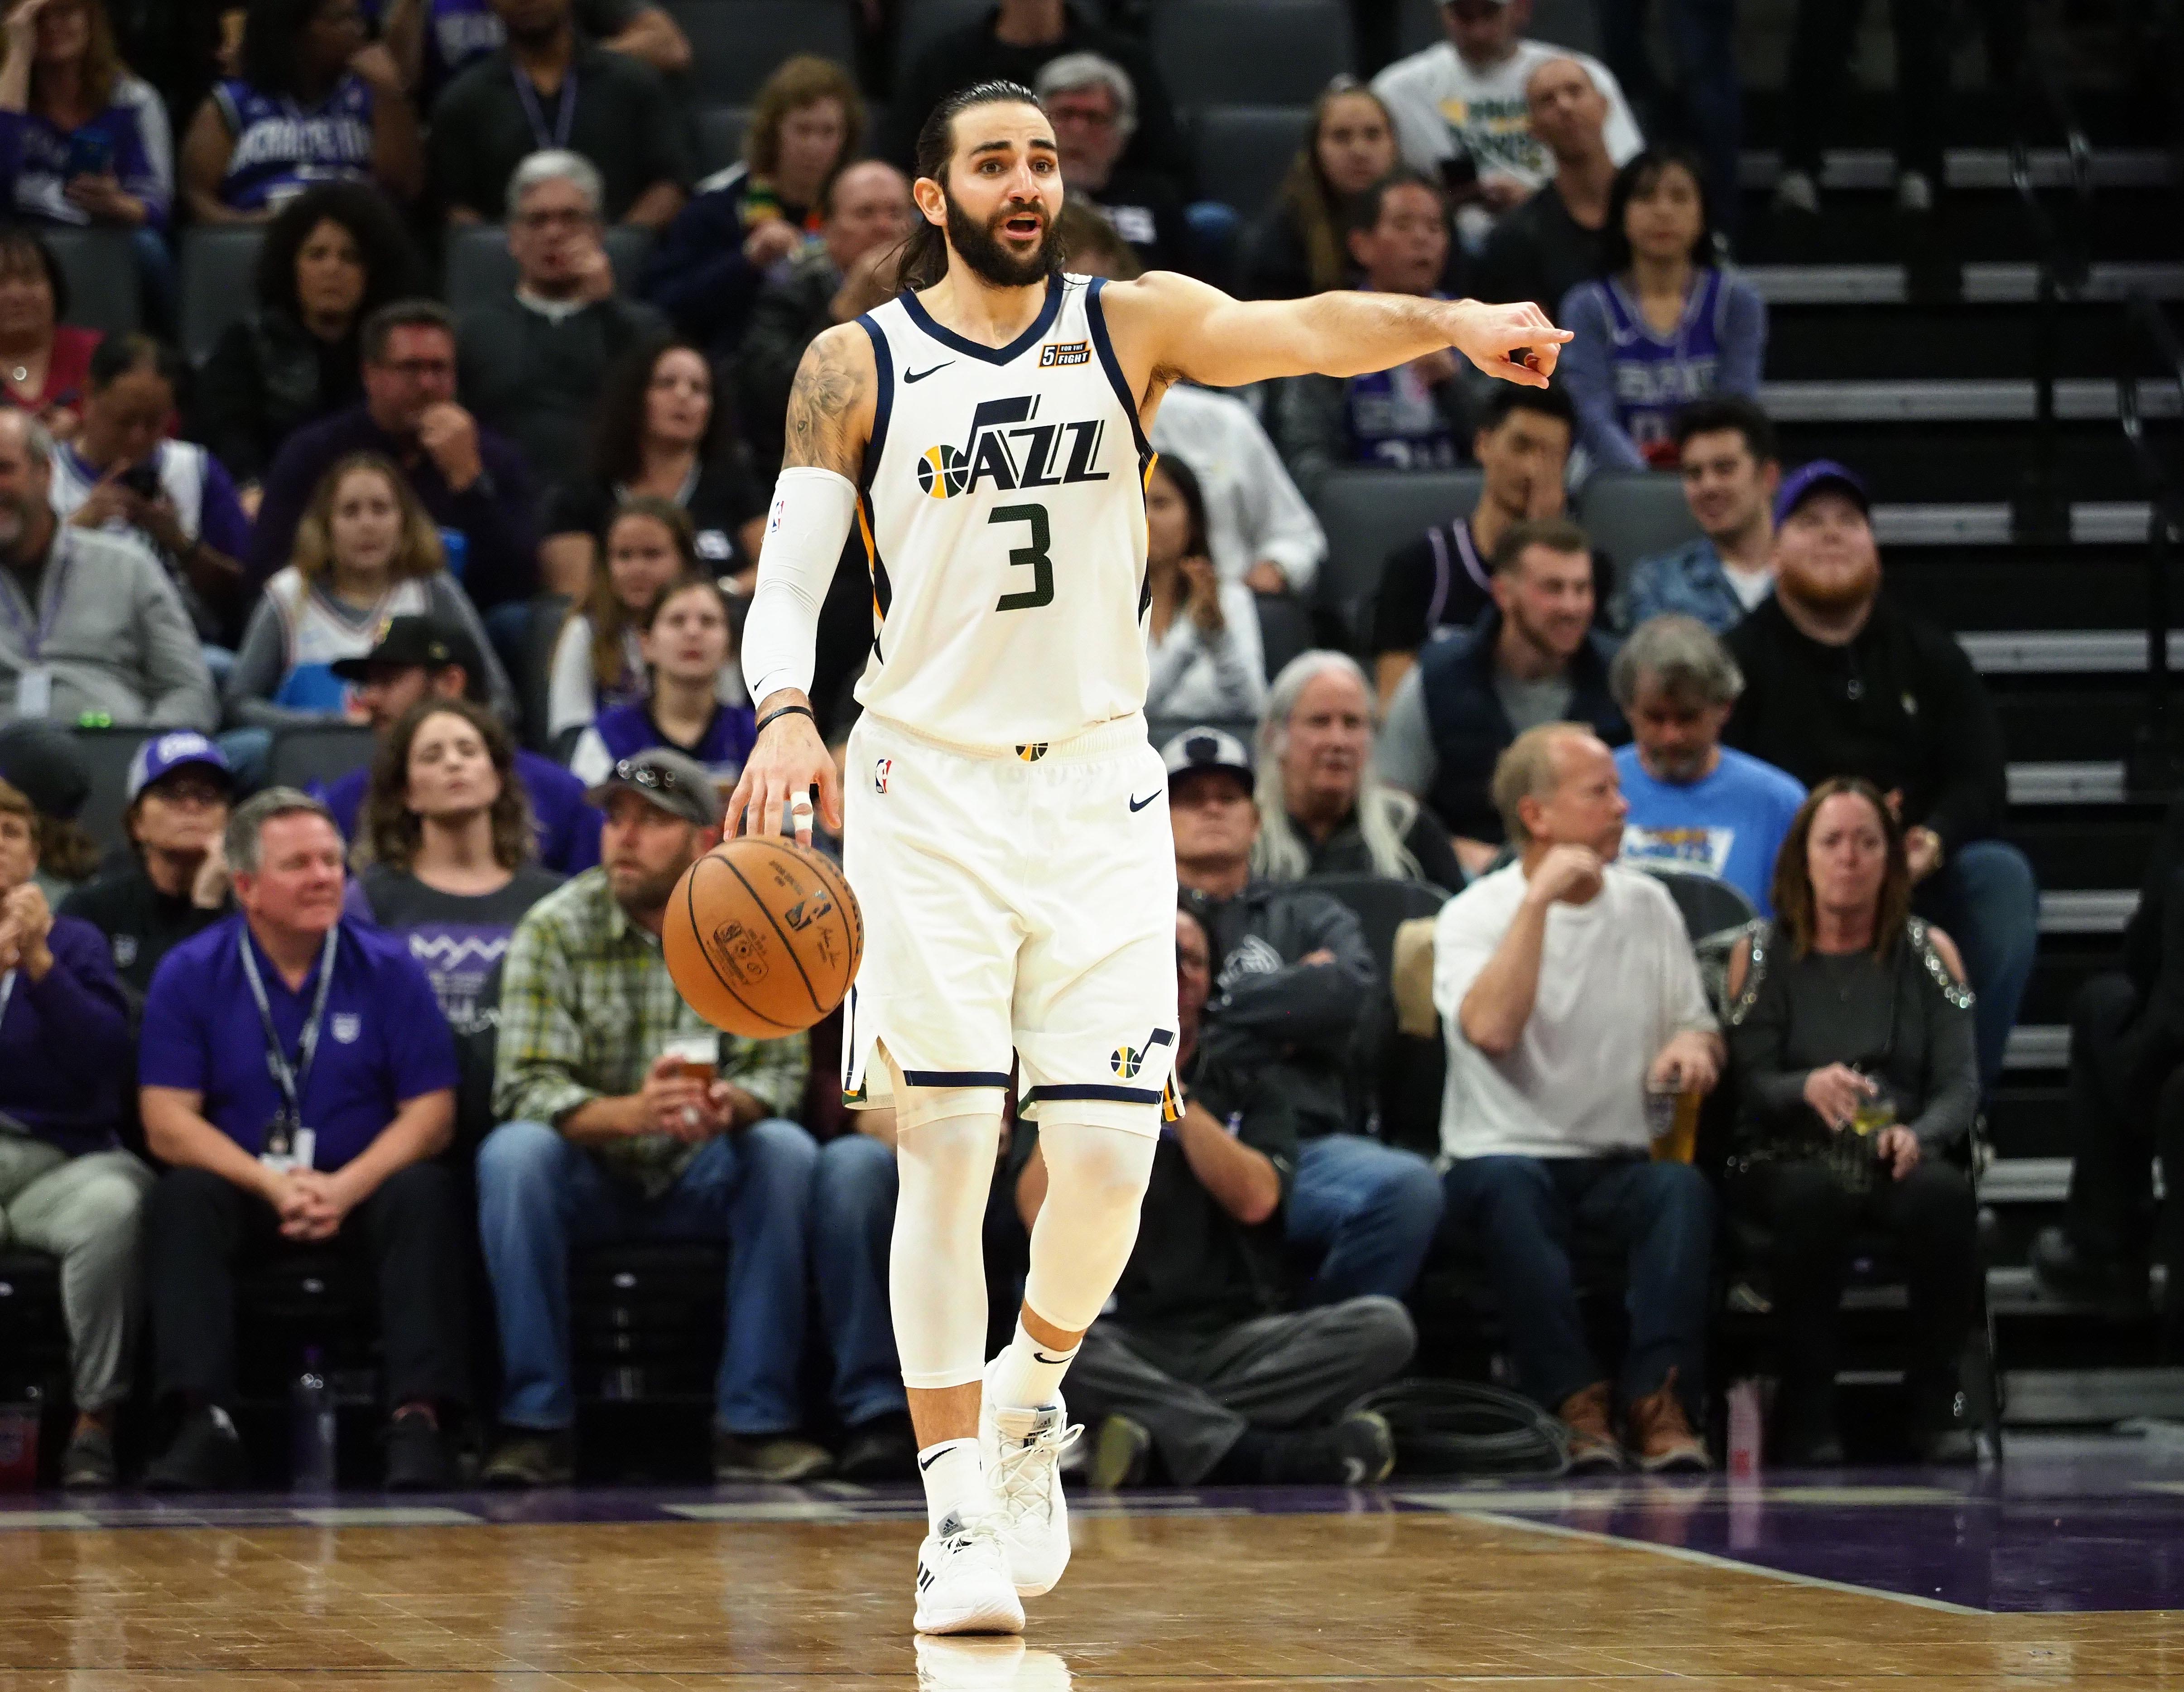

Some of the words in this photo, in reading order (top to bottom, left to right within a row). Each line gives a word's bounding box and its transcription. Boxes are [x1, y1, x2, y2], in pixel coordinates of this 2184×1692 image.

[1042, 346, 1055, 366] 5
[1058, 352, 1087, 364] FIGHT
[918, 394, 1109, 499] JAZZ
[988, 503, 1054, 612] 3
